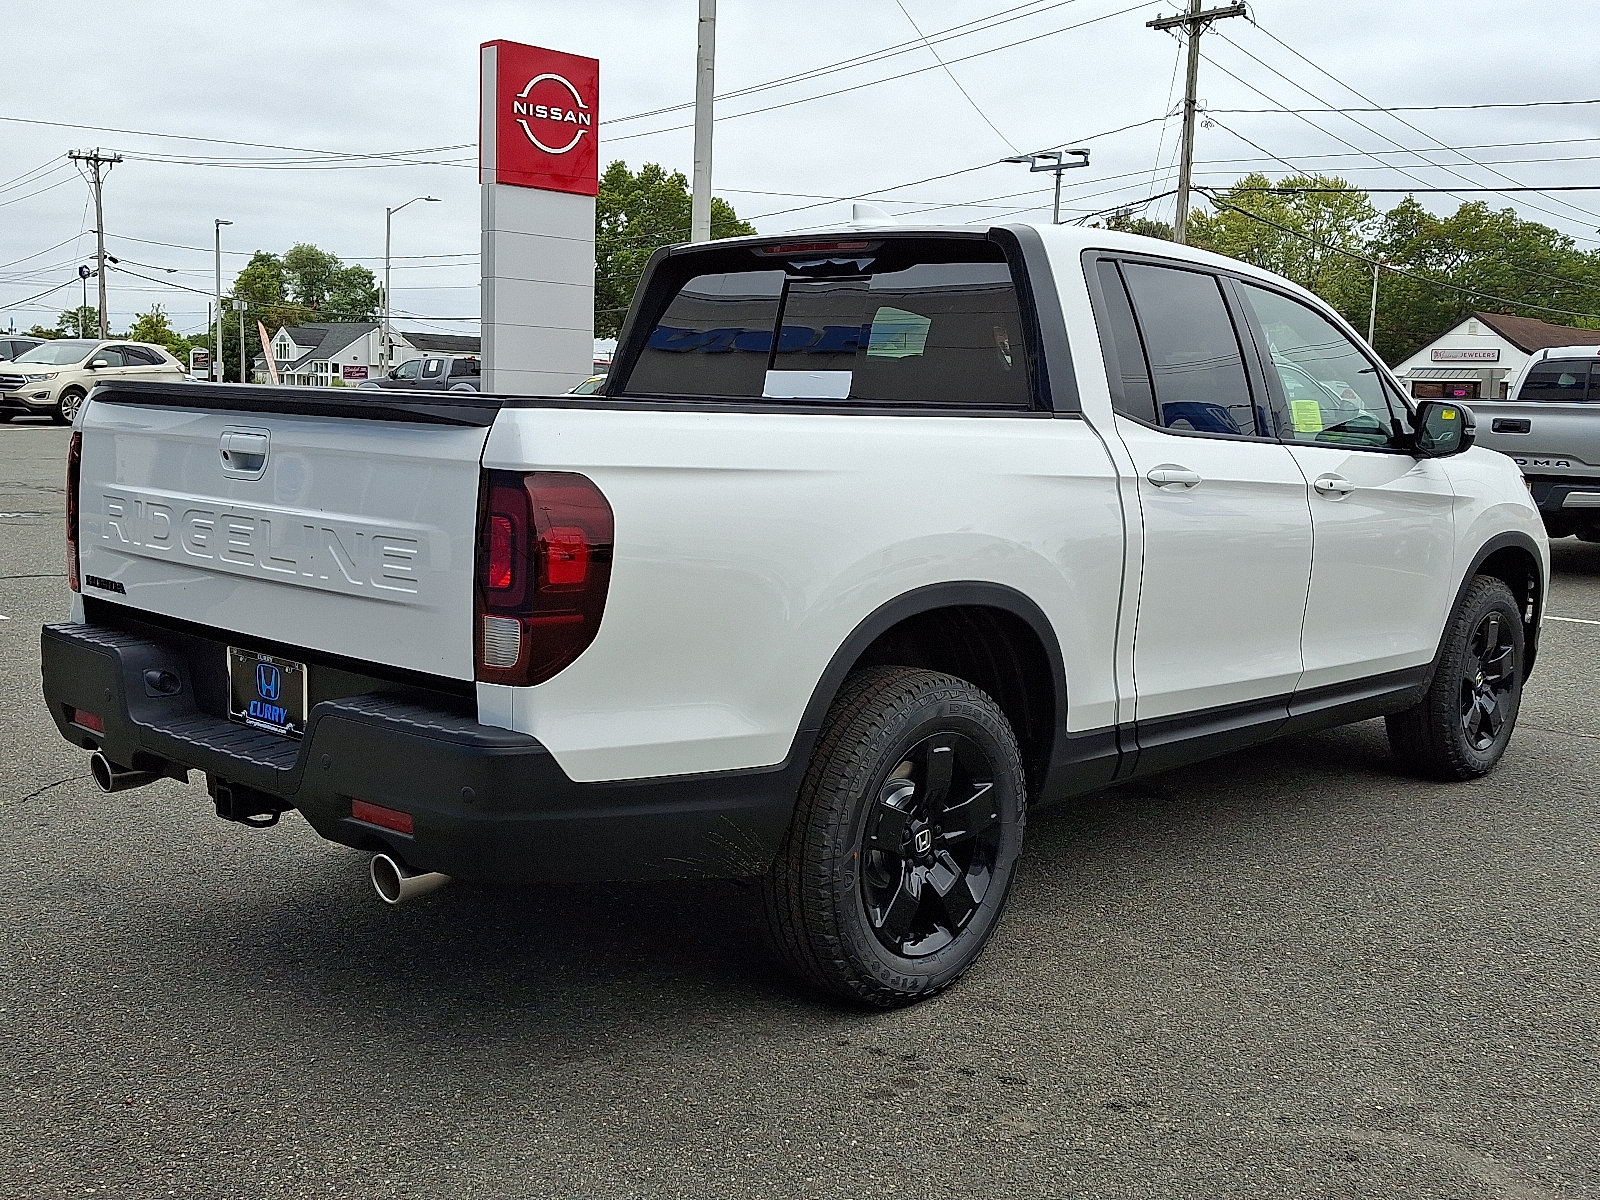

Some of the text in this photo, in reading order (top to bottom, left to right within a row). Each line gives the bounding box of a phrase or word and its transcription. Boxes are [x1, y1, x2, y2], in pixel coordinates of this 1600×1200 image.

[513, 101, 591, 126] NISSAN
[102, 494, 418, 593] RIDGELINE
[85, 574, 127, 595] HONDA
[249, 700, 288, 724] CURRY
